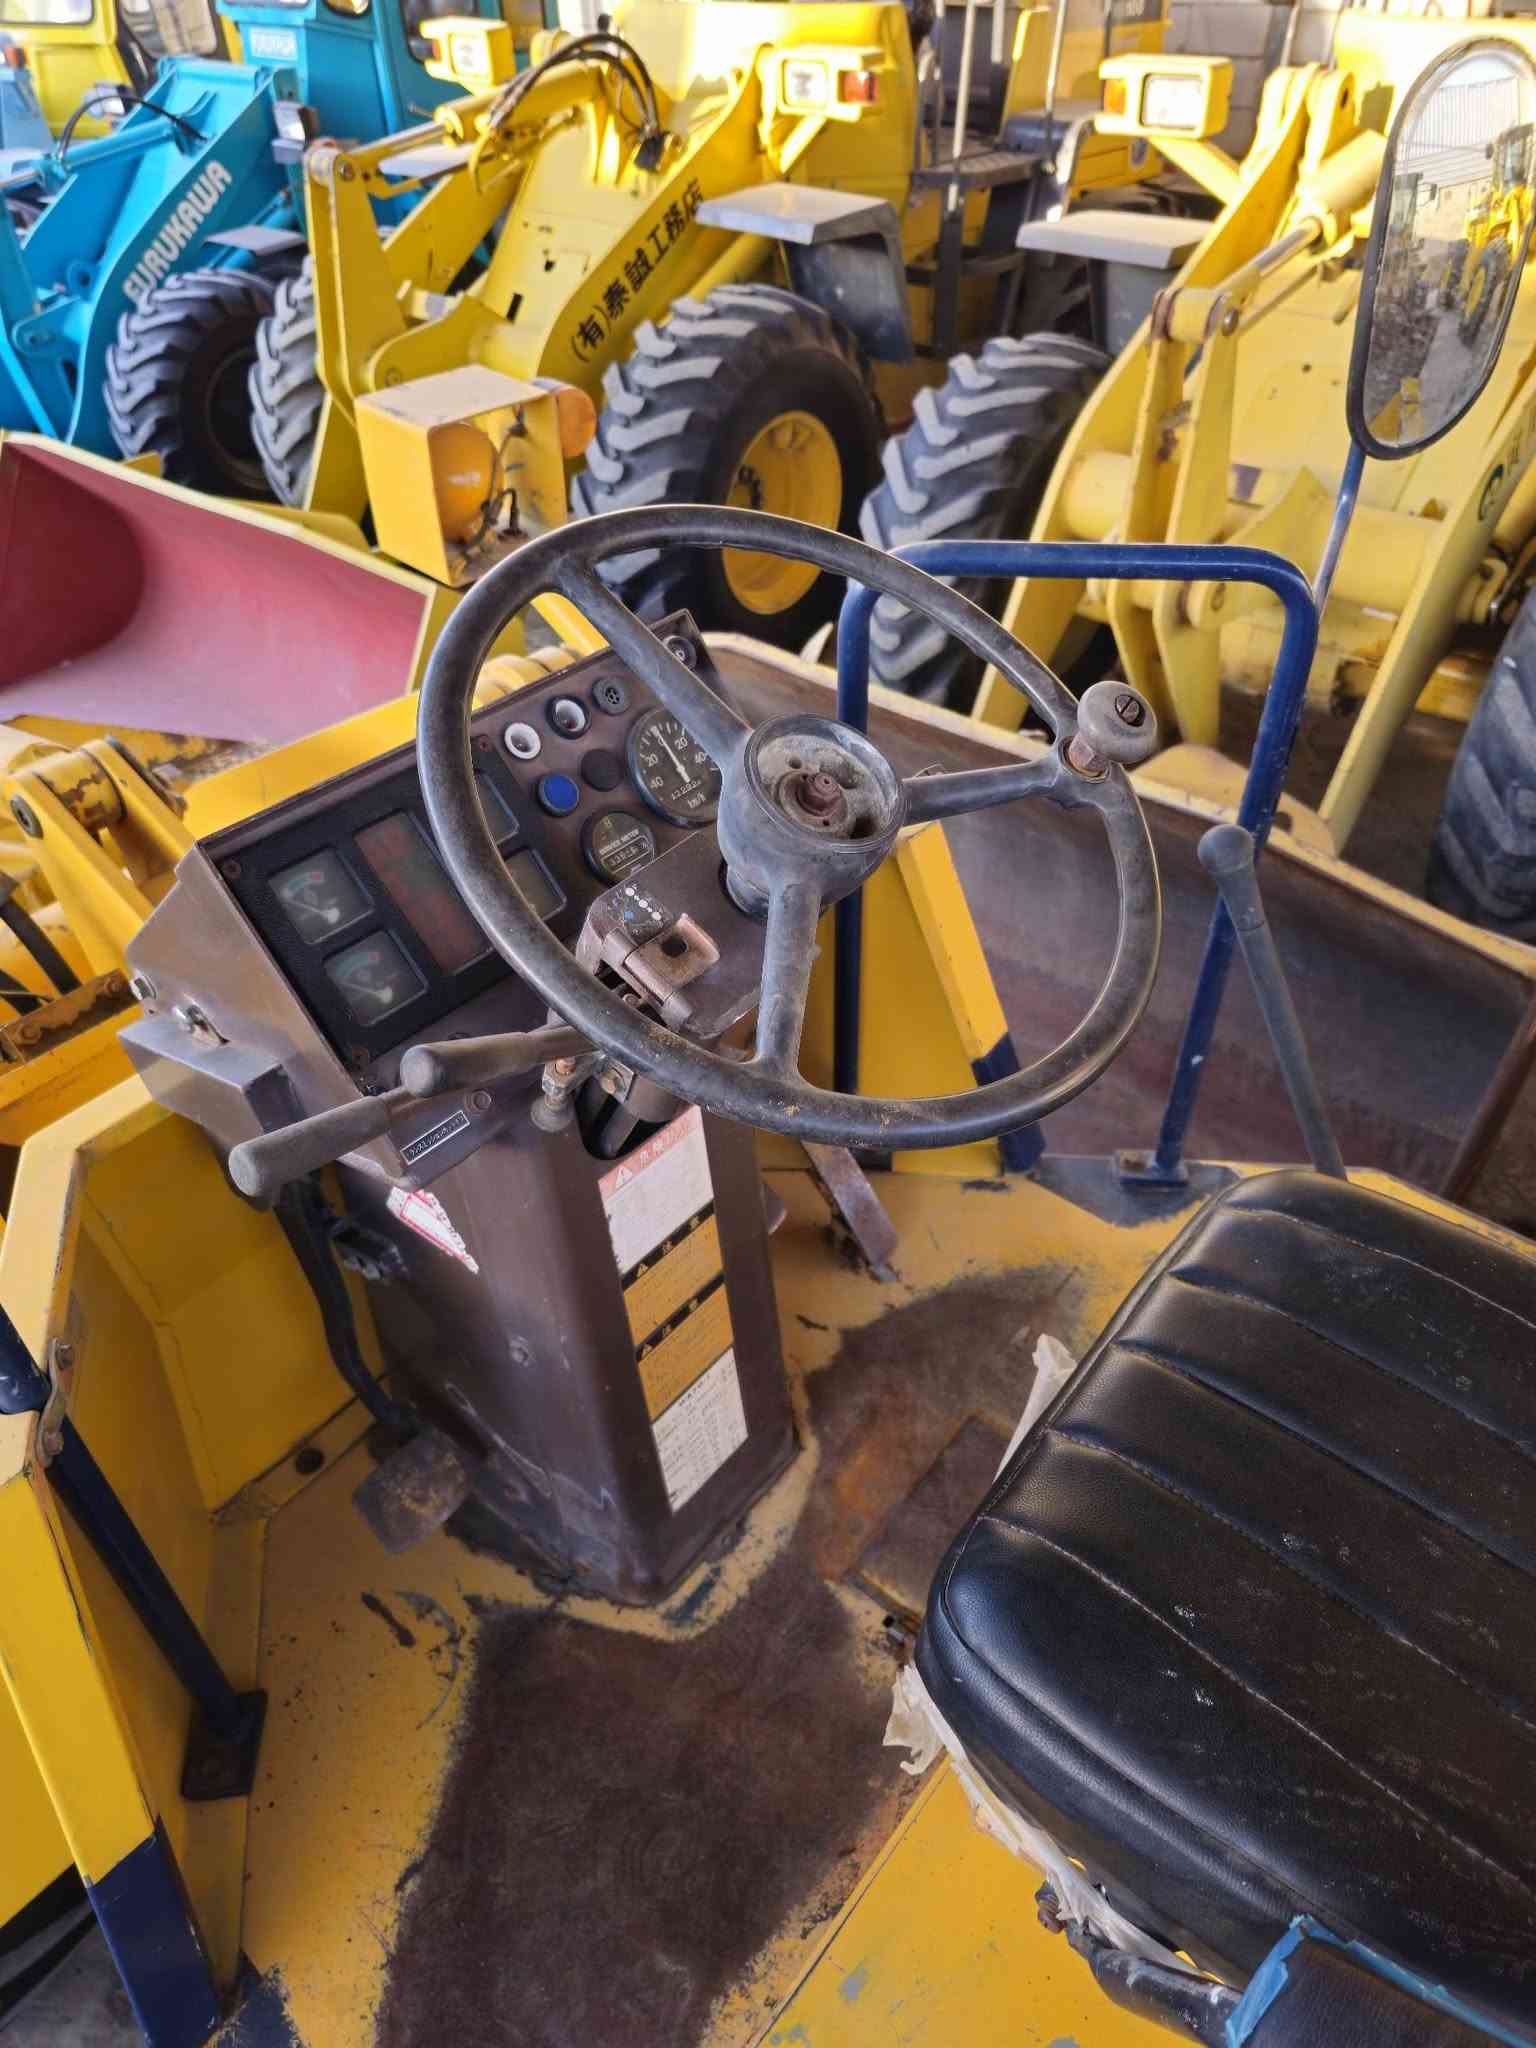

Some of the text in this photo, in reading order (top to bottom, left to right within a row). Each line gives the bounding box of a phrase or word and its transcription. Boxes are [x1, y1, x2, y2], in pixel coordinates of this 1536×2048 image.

[123, 160, 232, 303] FURUKAWA
[674, 736, 689, 750] 20
[645, 753, 658, 767] 20
